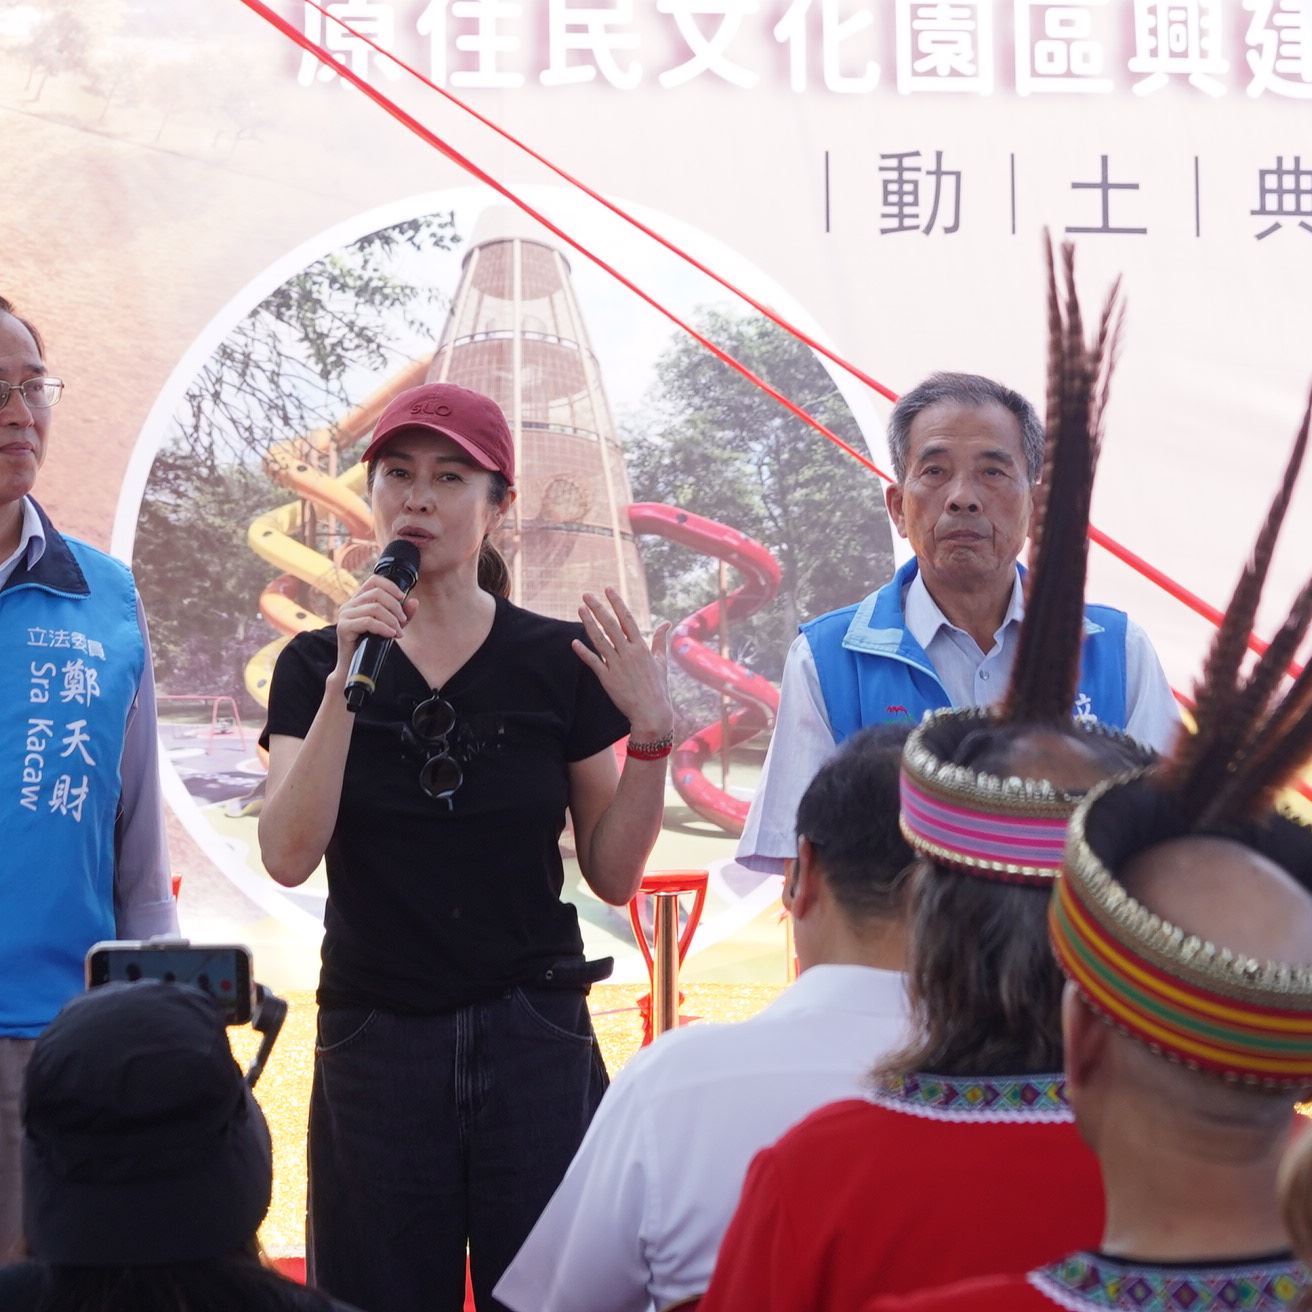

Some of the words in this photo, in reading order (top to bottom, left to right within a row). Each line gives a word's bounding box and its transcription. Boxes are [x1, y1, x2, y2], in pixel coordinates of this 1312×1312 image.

[29, 660, 57, 705] Sra
[19, 717, 54, 813] Kacaw
[47, 657, 101, 824] 鄭天財
